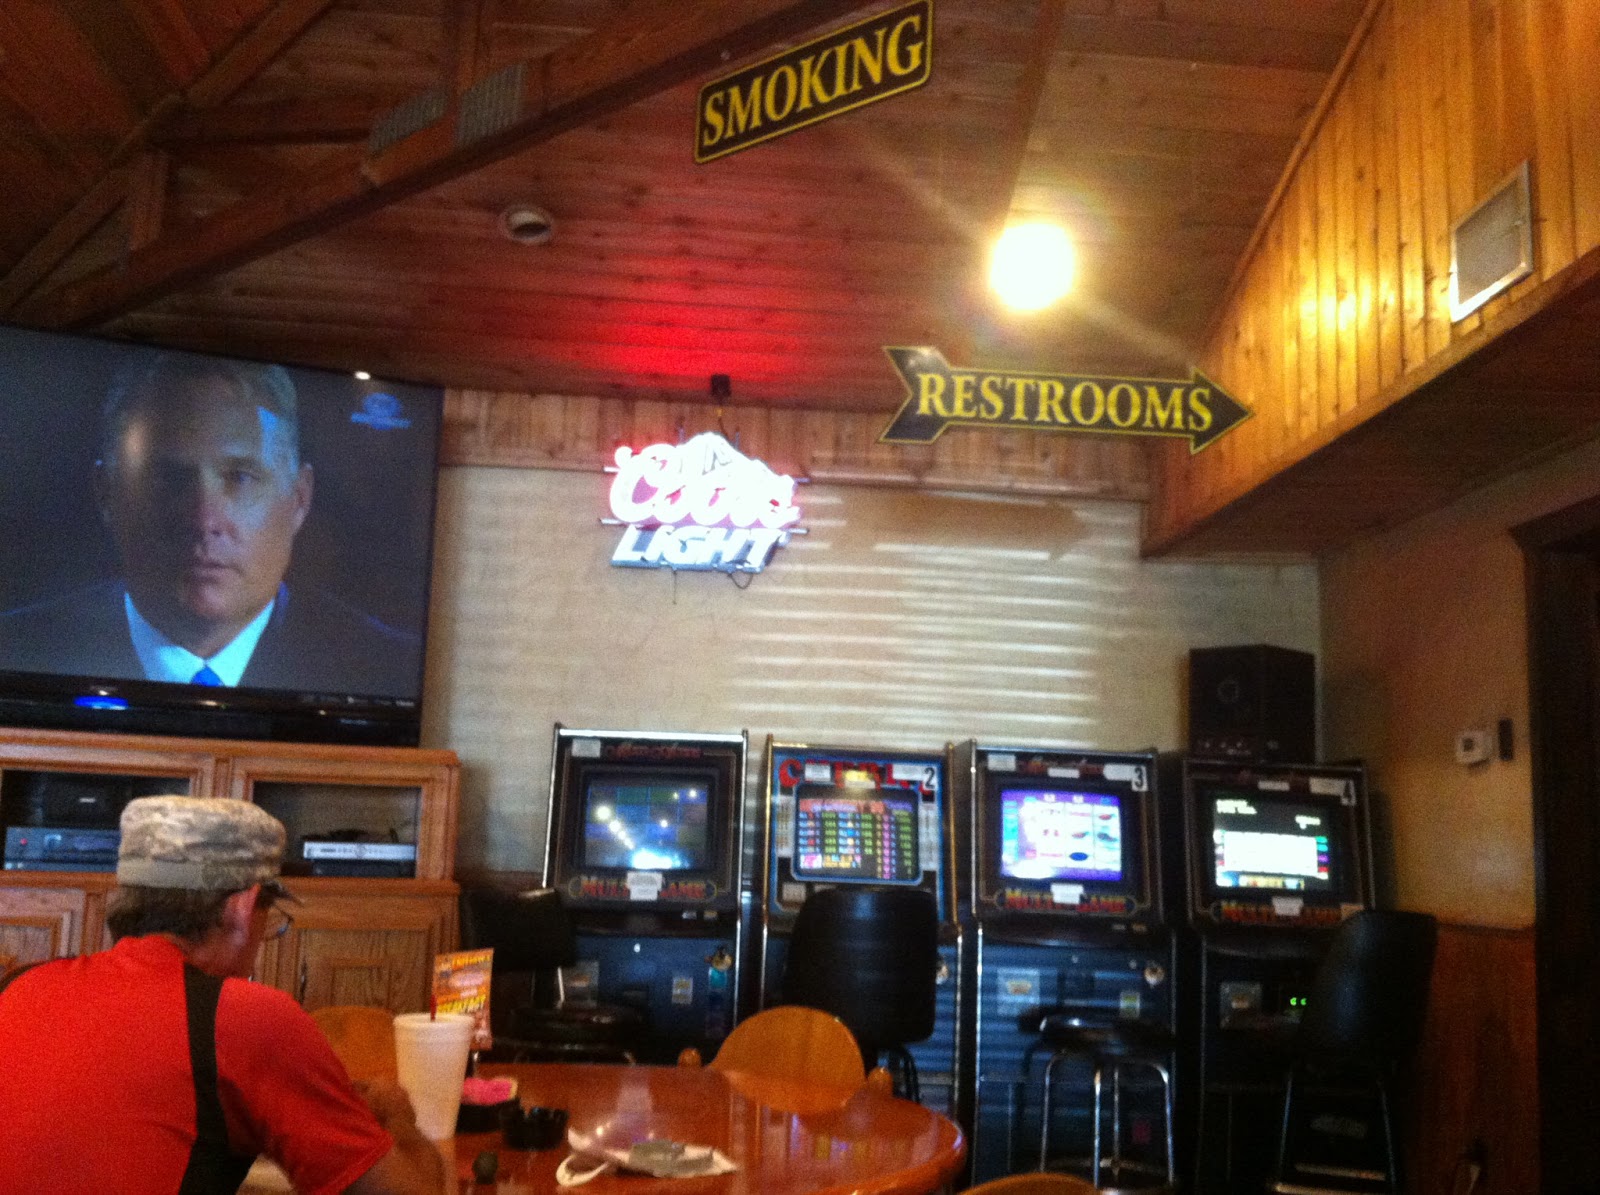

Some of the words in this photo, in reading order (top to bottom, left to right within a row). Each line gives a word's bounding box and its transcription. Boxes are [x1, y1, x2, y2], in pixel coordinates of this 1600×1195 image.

[702, 14, 925, 147] SMOKING
[915, 372, 1213, 432] RESTROOMS
[610, 524, 792, 573] LIGHT
[924, 766, 936, 789] 2
[1133, 765, 1144, 788] 3
